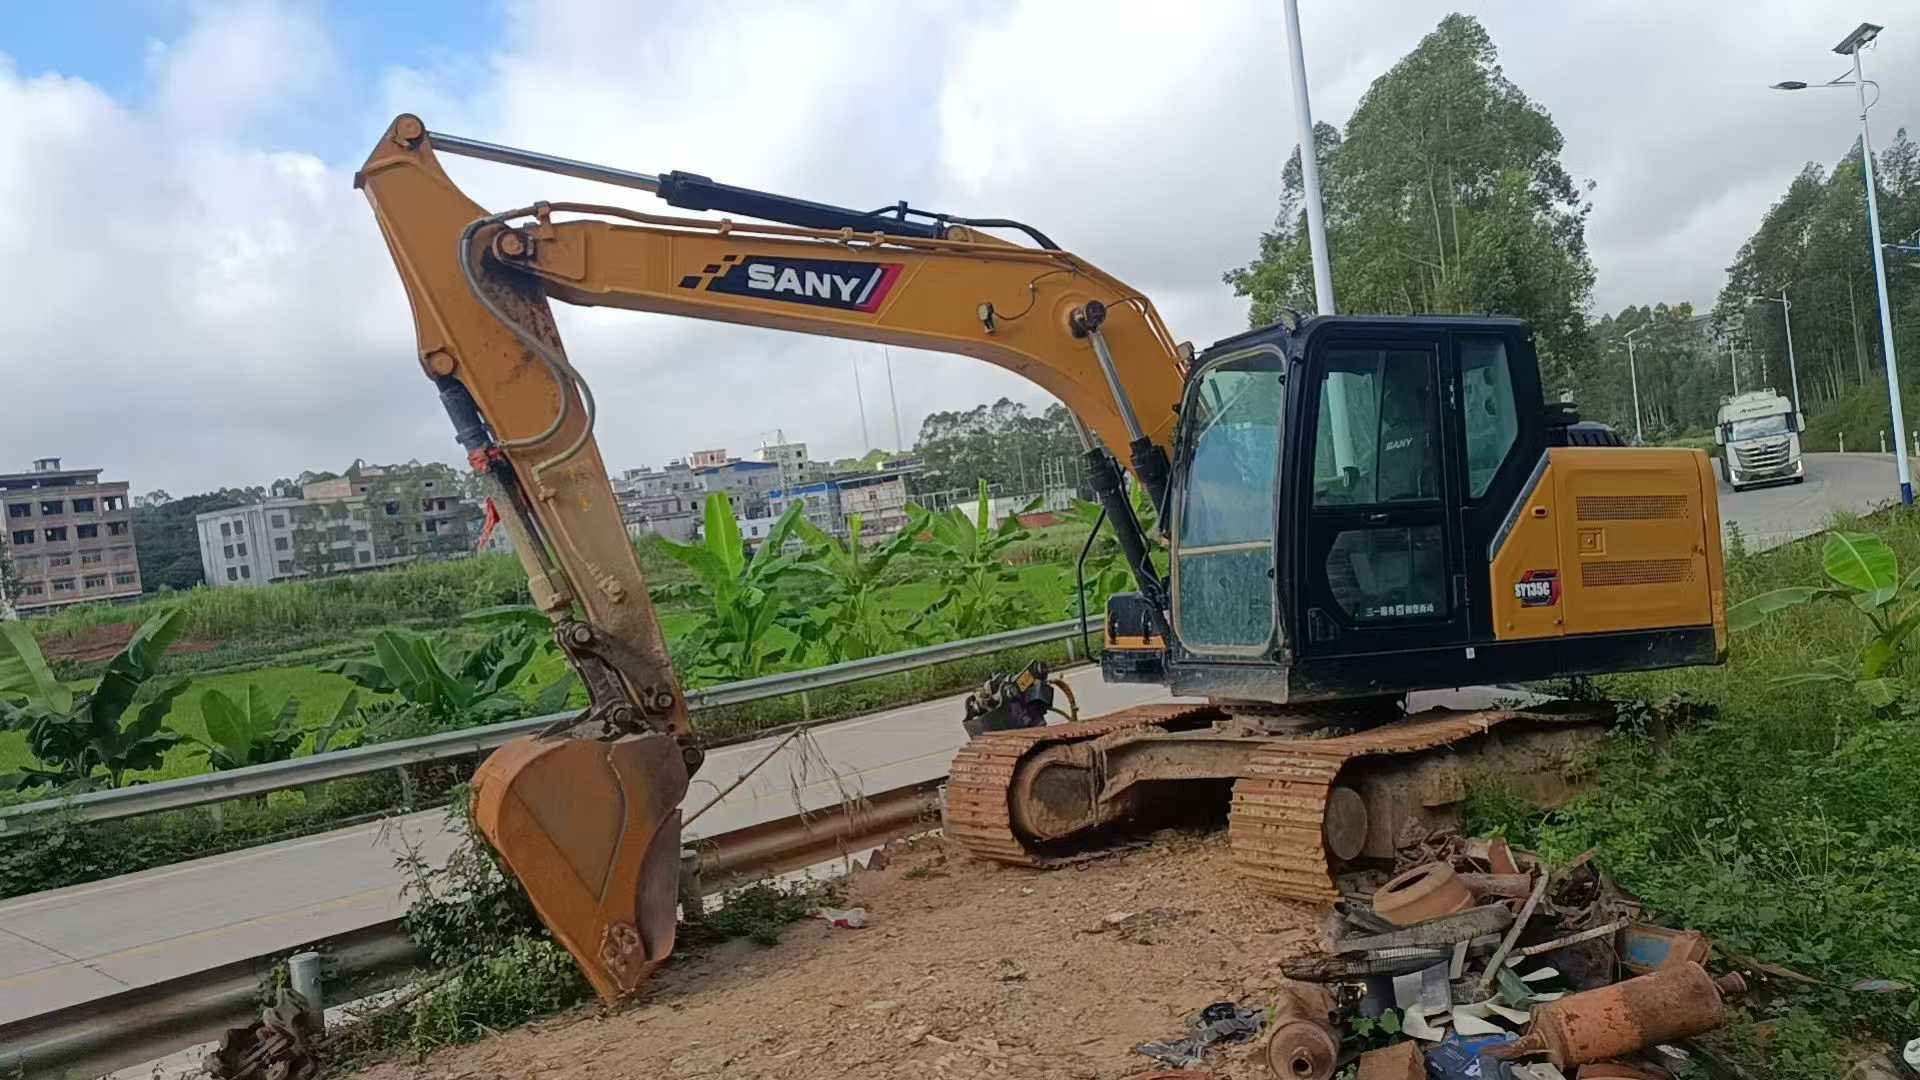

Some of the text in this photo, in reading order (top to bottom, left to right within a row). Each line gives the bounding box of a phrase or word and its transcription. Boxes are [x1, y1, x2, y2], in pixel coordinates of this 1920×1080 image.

[747, 263, 861, 302] SANY
[1384, 437, 1414, 452] SANY
[1514, 581, 1551, 598] SY135C
